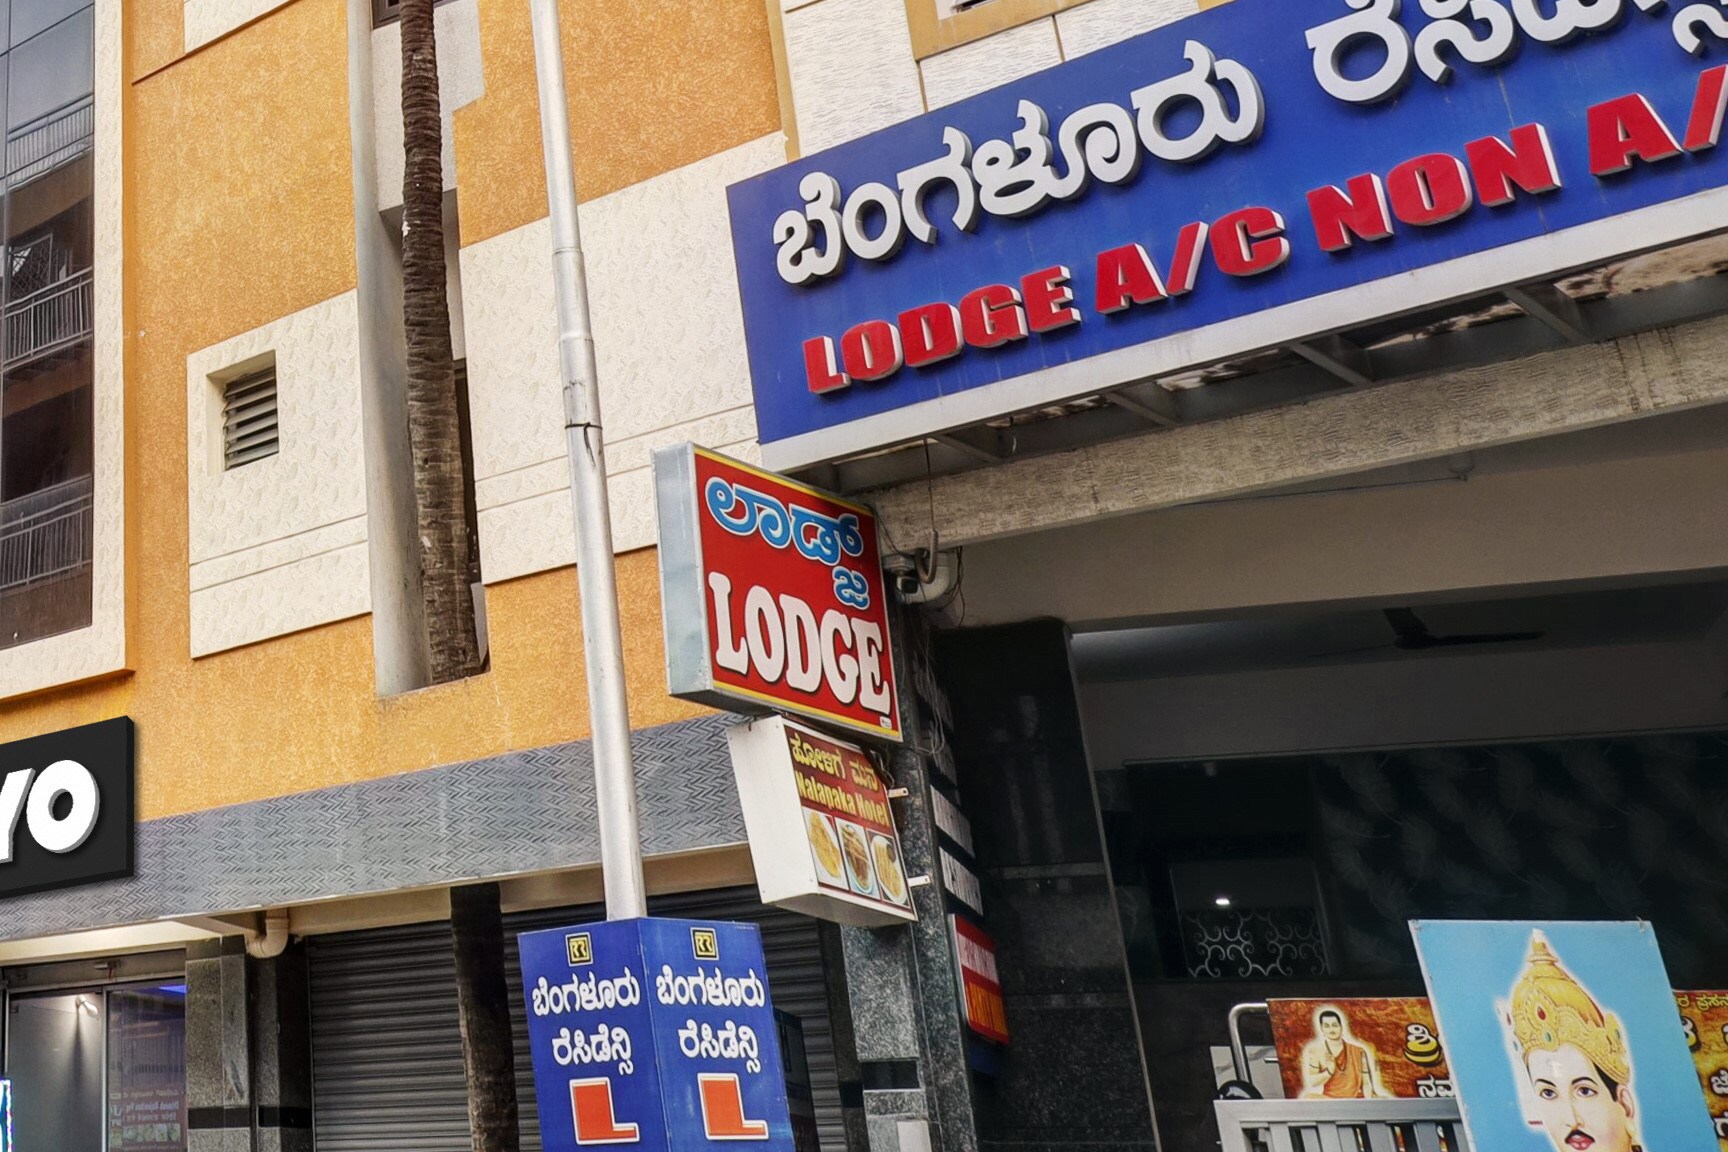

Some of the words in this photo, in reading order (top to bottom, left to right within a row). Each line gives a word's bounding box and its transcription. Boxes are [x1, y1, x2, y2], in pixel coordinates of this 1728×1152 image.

[773, 39, 1264, 285] ಬೆಂಗಳೂರು
[802, 265, 1081, 394] LODGE
[1095, 207, 1290, 314] A/C
[1305, 123, 1563, 252] NON
[705, 476, 871, 610] ಲಾಡ್ಜ್
[708, 571, 892, 715] LODGE
[795, 771, 856, 815] Nalapaka
[856, 793, 892, 827] Hotel
[532, 966, 641, 1017] ಬೆಂಗಳೂರು
[656, 964, 765, 1008] ಬೆಂಗಳೂರು
[552, 1023, 634, 1076] ರೆಸಿಡೆನ್ಸಿ
[678, 1018, 761, 1074] ರೆಸಿಡೆನ್ಸಿ
[569, 1076, 640, 1145] L
[697, 1072, 769, 1141] L
